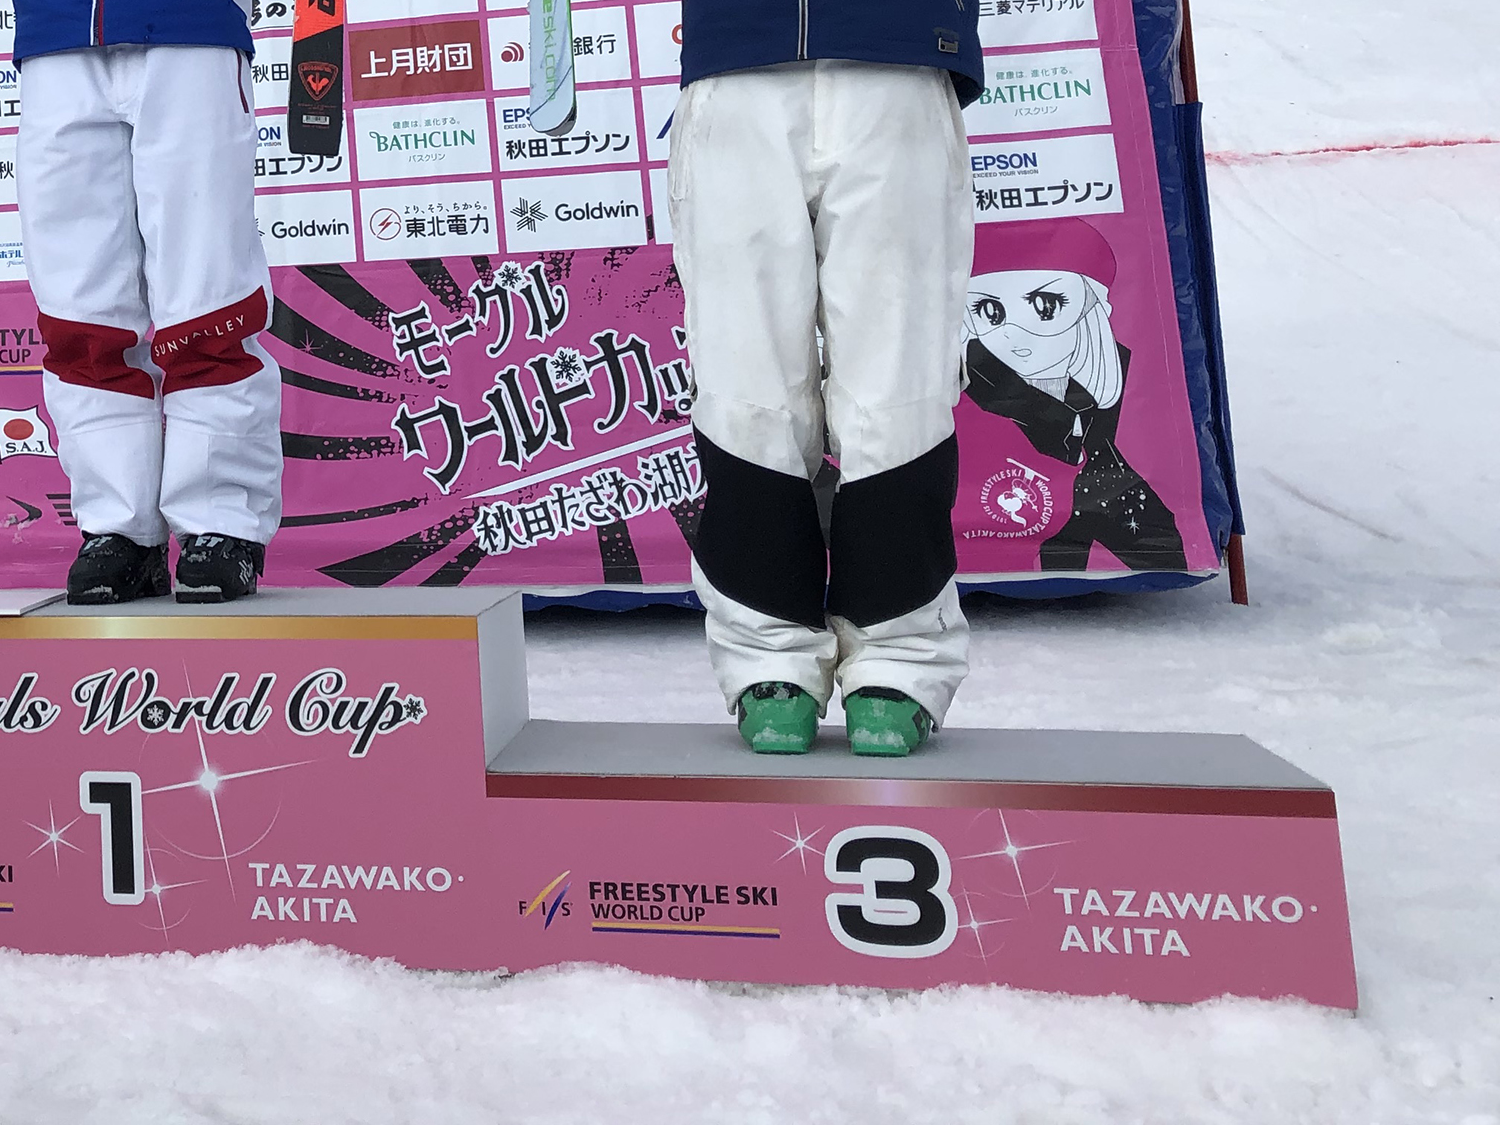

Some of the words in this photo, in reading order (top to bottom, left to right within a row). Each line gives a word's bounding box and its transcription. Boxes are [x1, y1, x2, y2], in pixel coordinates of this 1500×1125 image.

[361, 42, 474, 78] 上月財団
[979, 78, 1092, 105] BATHCLIN
[370, 129, 476, 153] BATHCLIN
[505, 131, 630, 160] 秋田エプソン
[971, 152, 1038, 172] EPSON
[975, 179, 1114, 211] 秋田エプソン
[554, 200, 639, 222] Goldwin
[271, 218, 349, 239] Goldwin
[405, 213, 489, 238] 東北電力
[389, 261, 569, 378] モーグル
[391, 329, 693, 494] ワールドカッ
[1006, 468, 1023, 478] SKI
[1035, 479, 1053, 506] WORLD
[962, 529, 996, 539] AKITA
[71, 668, 271, 735] World
[284, 667, 407, 758] Cup
[79, 770, 144, 906] 1
[588, 880, 730, 905] FREESTYLE
[735, 885, 779, 907] SKI
[825, 824, 959, 958] 3
[251, 896, 358, 923] AKITA
[590, 902, 663, 921] WORLD
[666, 904, 706, 923] CUP
[1060, 926, 1192, 958] AKITA
